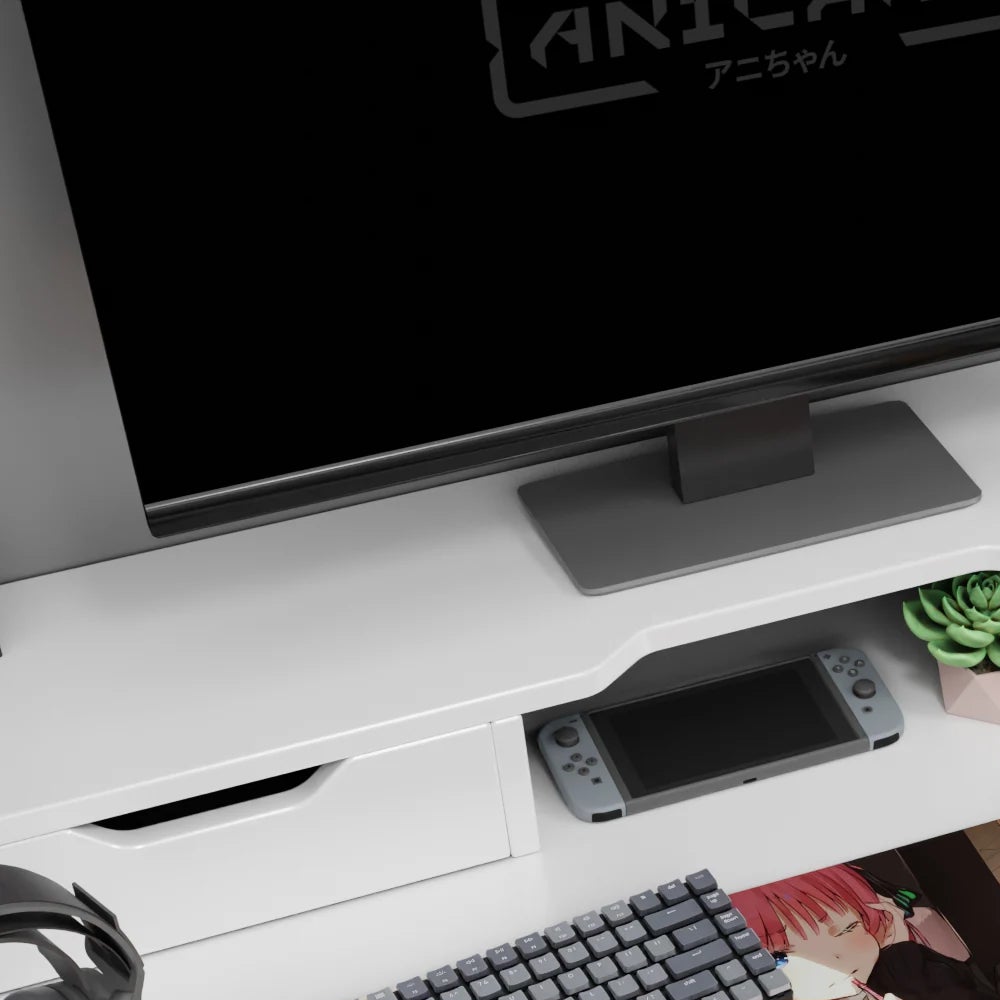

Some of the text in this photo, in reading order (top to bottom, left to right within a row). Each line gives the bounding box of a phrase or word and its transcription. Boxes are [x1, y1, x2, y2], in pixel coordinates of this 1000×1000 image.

[706, 40, 848, 90] アニちゃん
